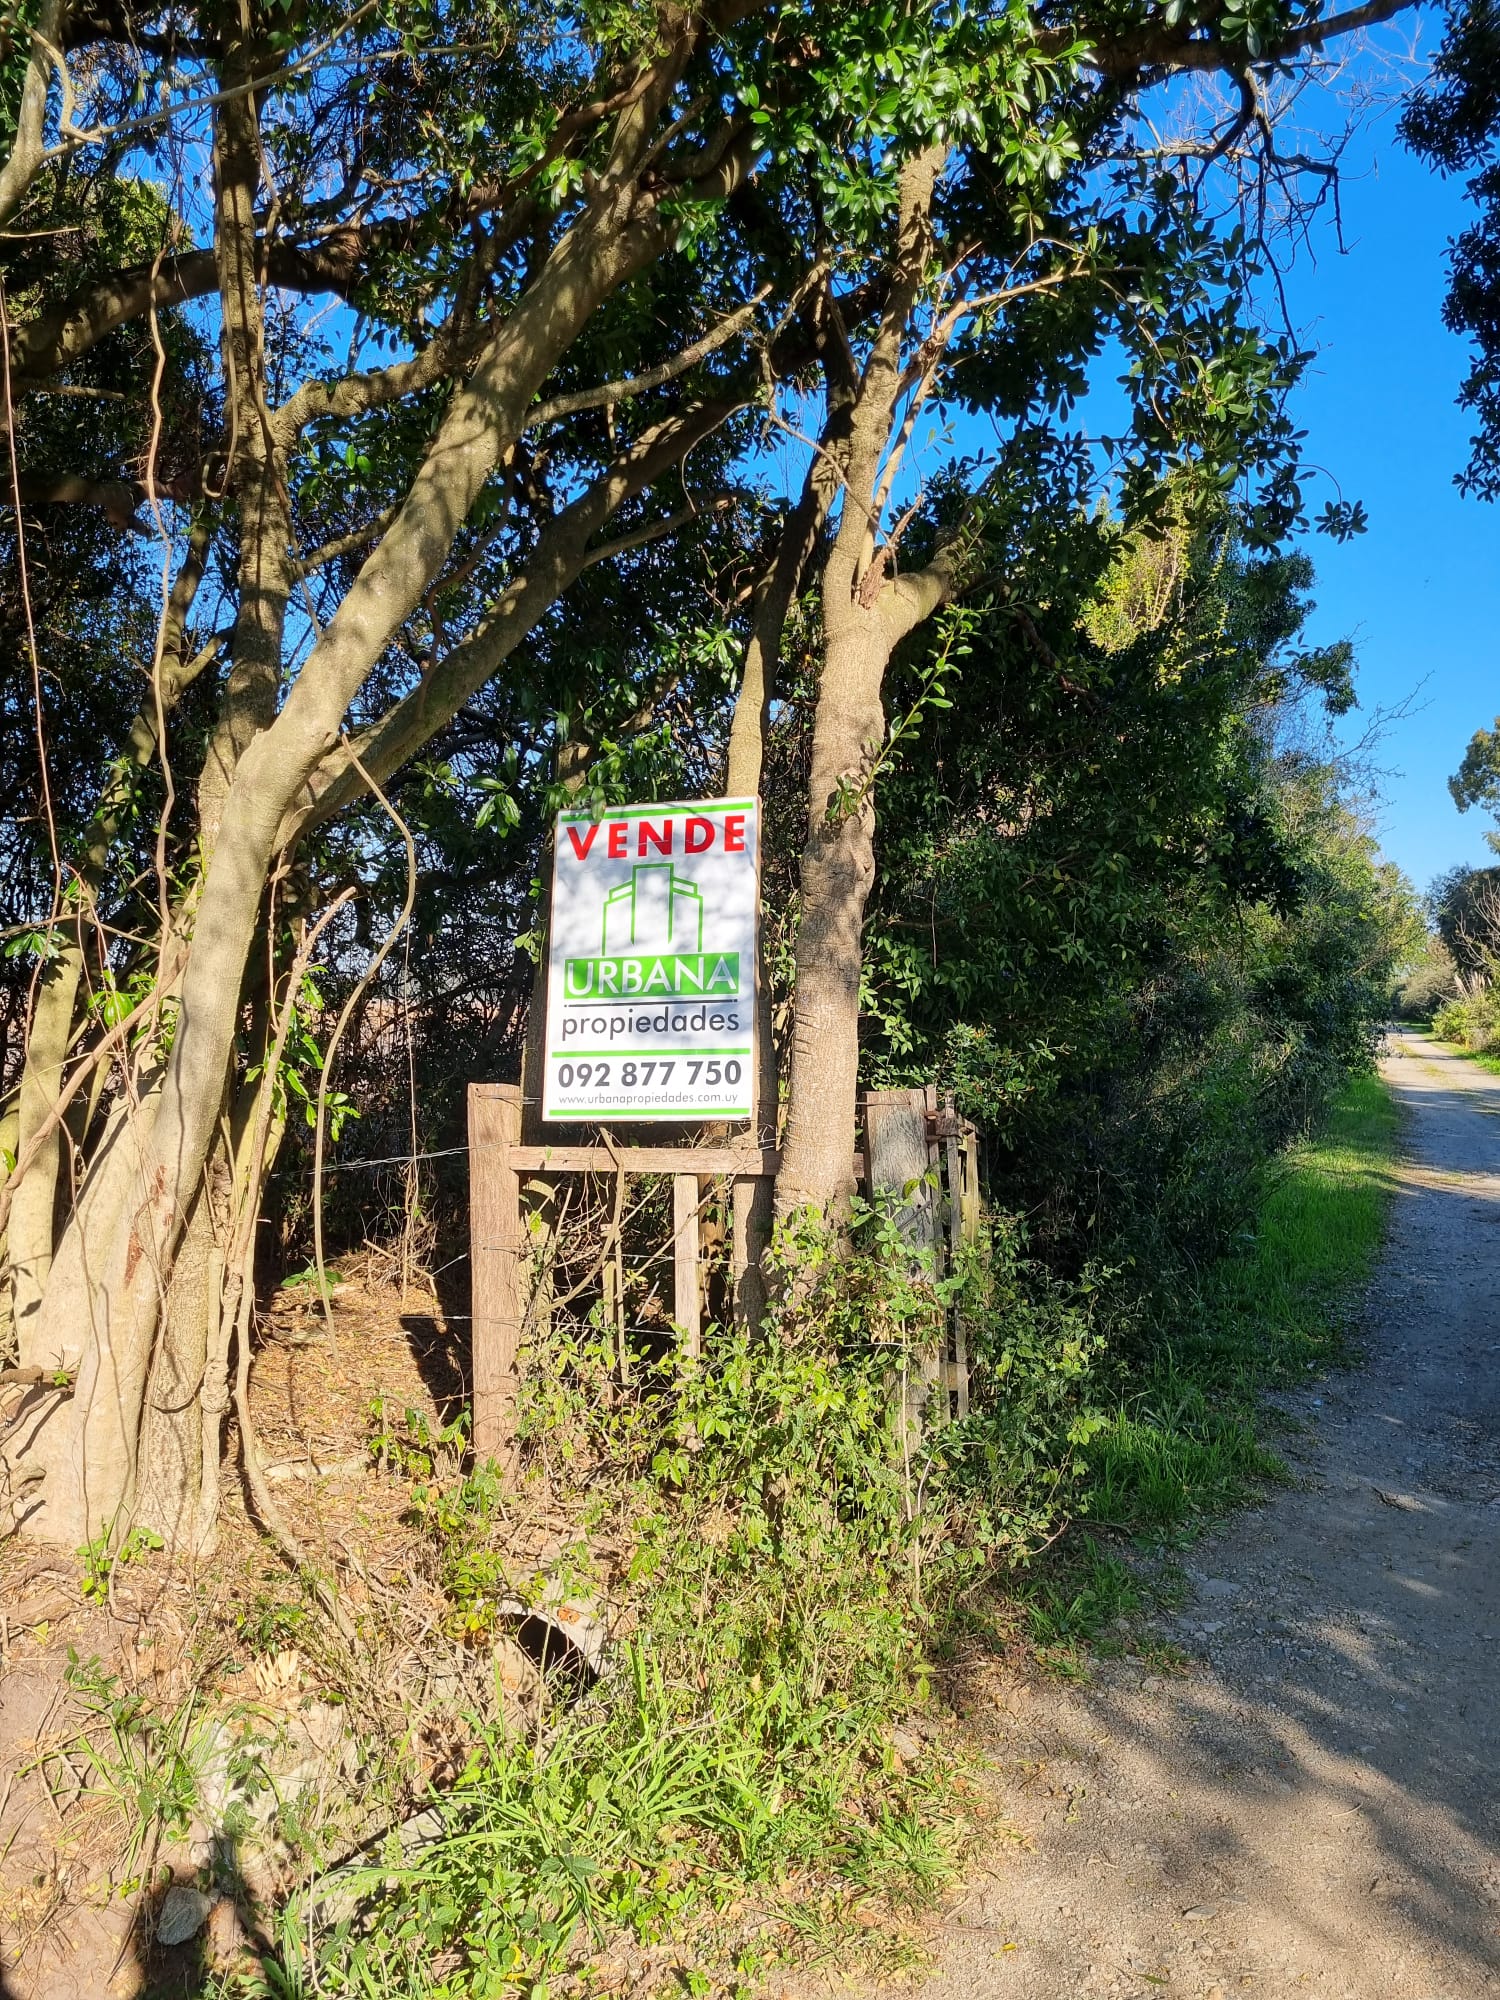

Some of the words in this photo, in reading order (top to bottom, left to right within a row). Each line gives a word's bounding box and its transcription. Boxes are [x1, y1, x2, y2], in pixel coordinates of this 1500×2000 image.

[566, 815, 746, 861] VENDE
[567, 956, 738, 996] URBANA
[562, 1005, 740, 1042] propiedades
[558, 1062, 611, 1088] 092
[621, 1061, 676, 1087] 877
[686, 1060, 742, 1085] 750
[558, 1091, 738, 1106] www.urbanapropiedades.com.uy
